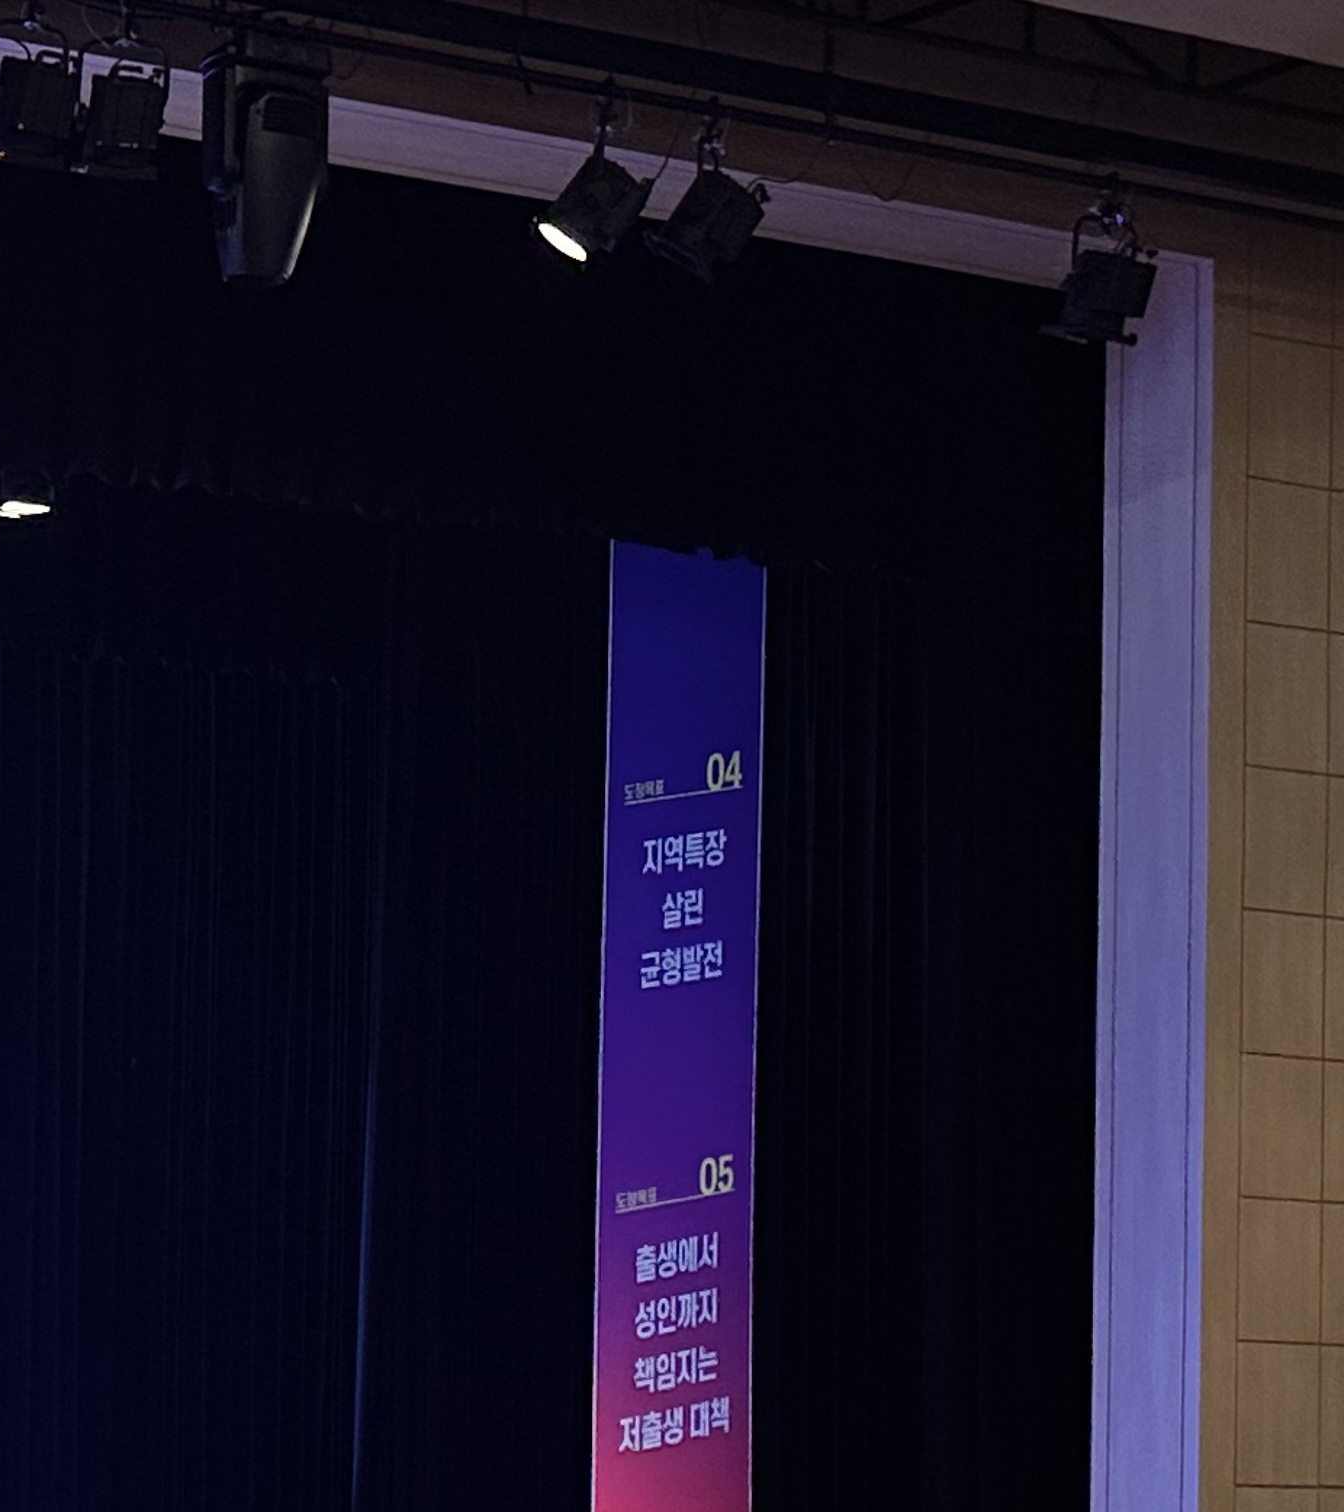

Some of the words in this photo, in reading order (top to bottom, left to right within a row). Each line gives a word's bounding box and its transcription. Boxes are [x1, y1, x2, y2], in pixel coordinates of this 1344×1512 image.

[706, 750, 743, 791] 04
[642, 829, 727, 875] 지역특장
[662, 888, 704, 929] 살린
[640, 940, 723, 988] 균형발전
[699, 1154, 735, 1195] 05
[635, 1231, 719, 1282] 출생에서
[634, 1288, 718, 1339] 성인까지
[633, 1346, 719, 1392] 책임지는
[618, 1407, 683, 1453] 저출생
[689, 1396, 731, 1438] 대책
